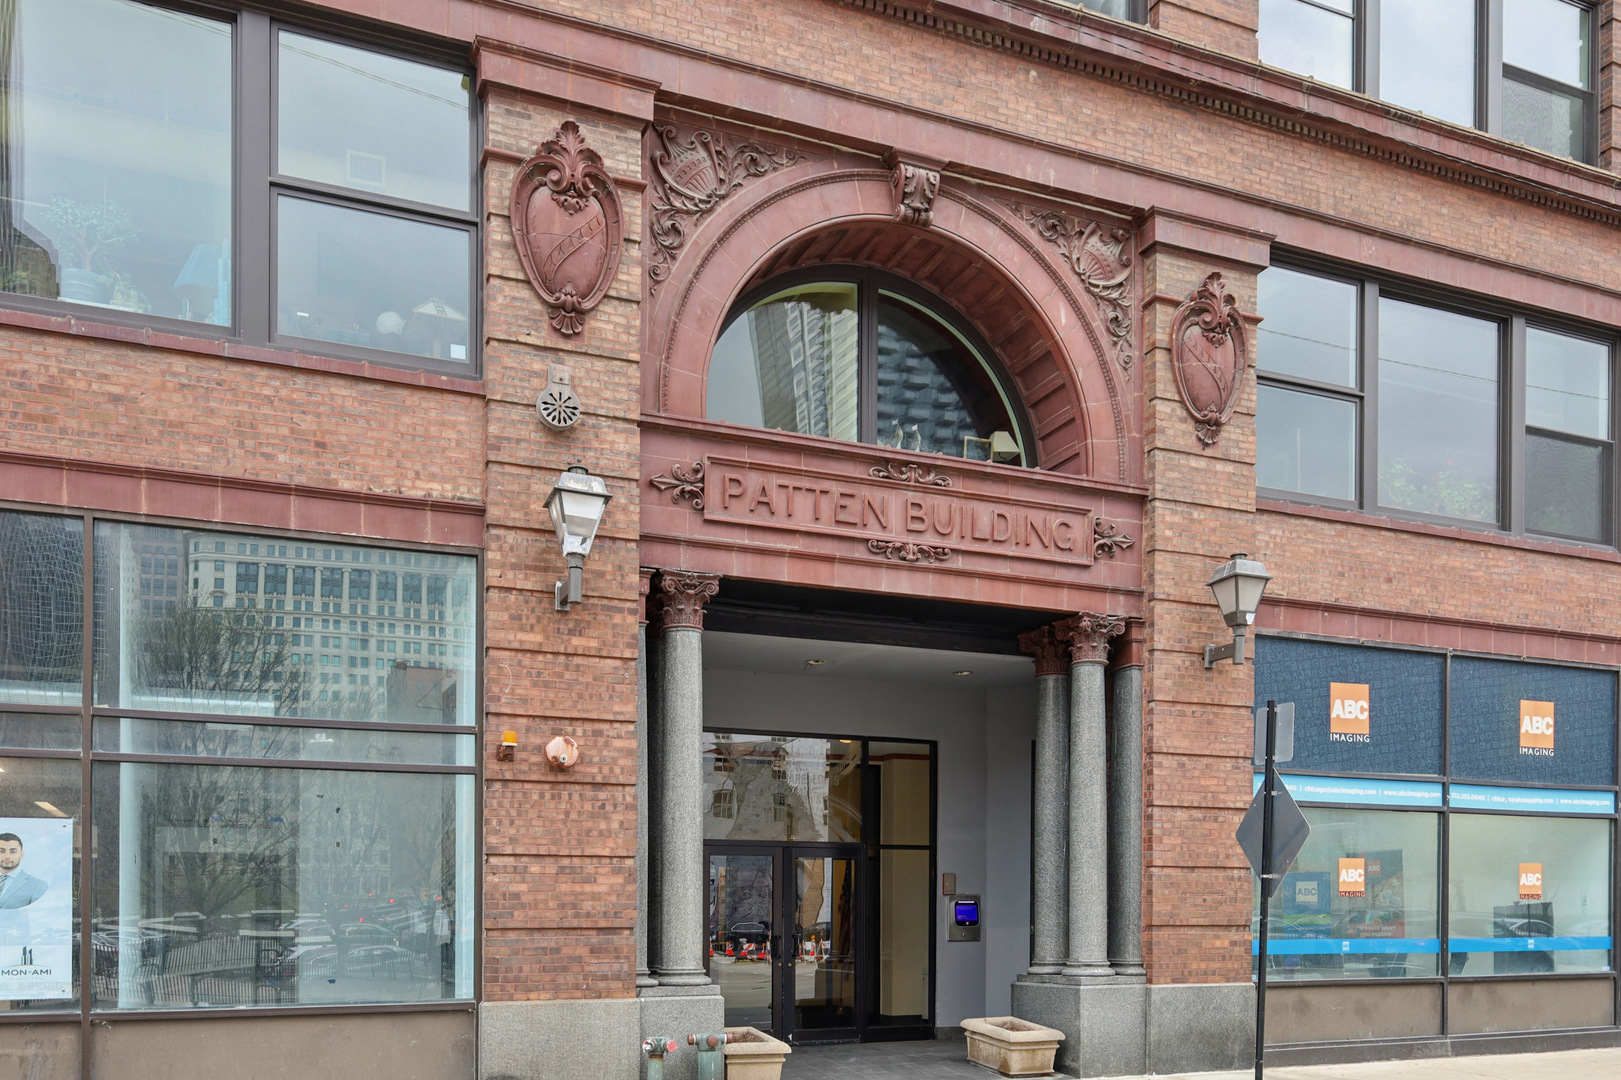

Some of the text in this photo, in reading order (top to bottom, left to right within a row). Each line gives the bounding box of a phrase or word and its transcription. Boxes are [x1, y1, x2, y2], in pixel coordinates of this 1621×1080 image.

[723, 473, 1075, 551] PATTEN BUILDING
[1331, 698, 1369, 720] ABC
[1520, 715, 1554, 736] ABC
[1330, 733, 1370, 743] IMAGING
[1519, 747, 1555, 757] IMAGING
[1383, 789, 1441, 798] www.abcimaging.com
[1339, 869, 1365, 882] ABC
[1519, 873, 1542, 886] ABC
[1296, 887, 1317, 897] ABC
[1, 968, 52, 977] MON AMI
